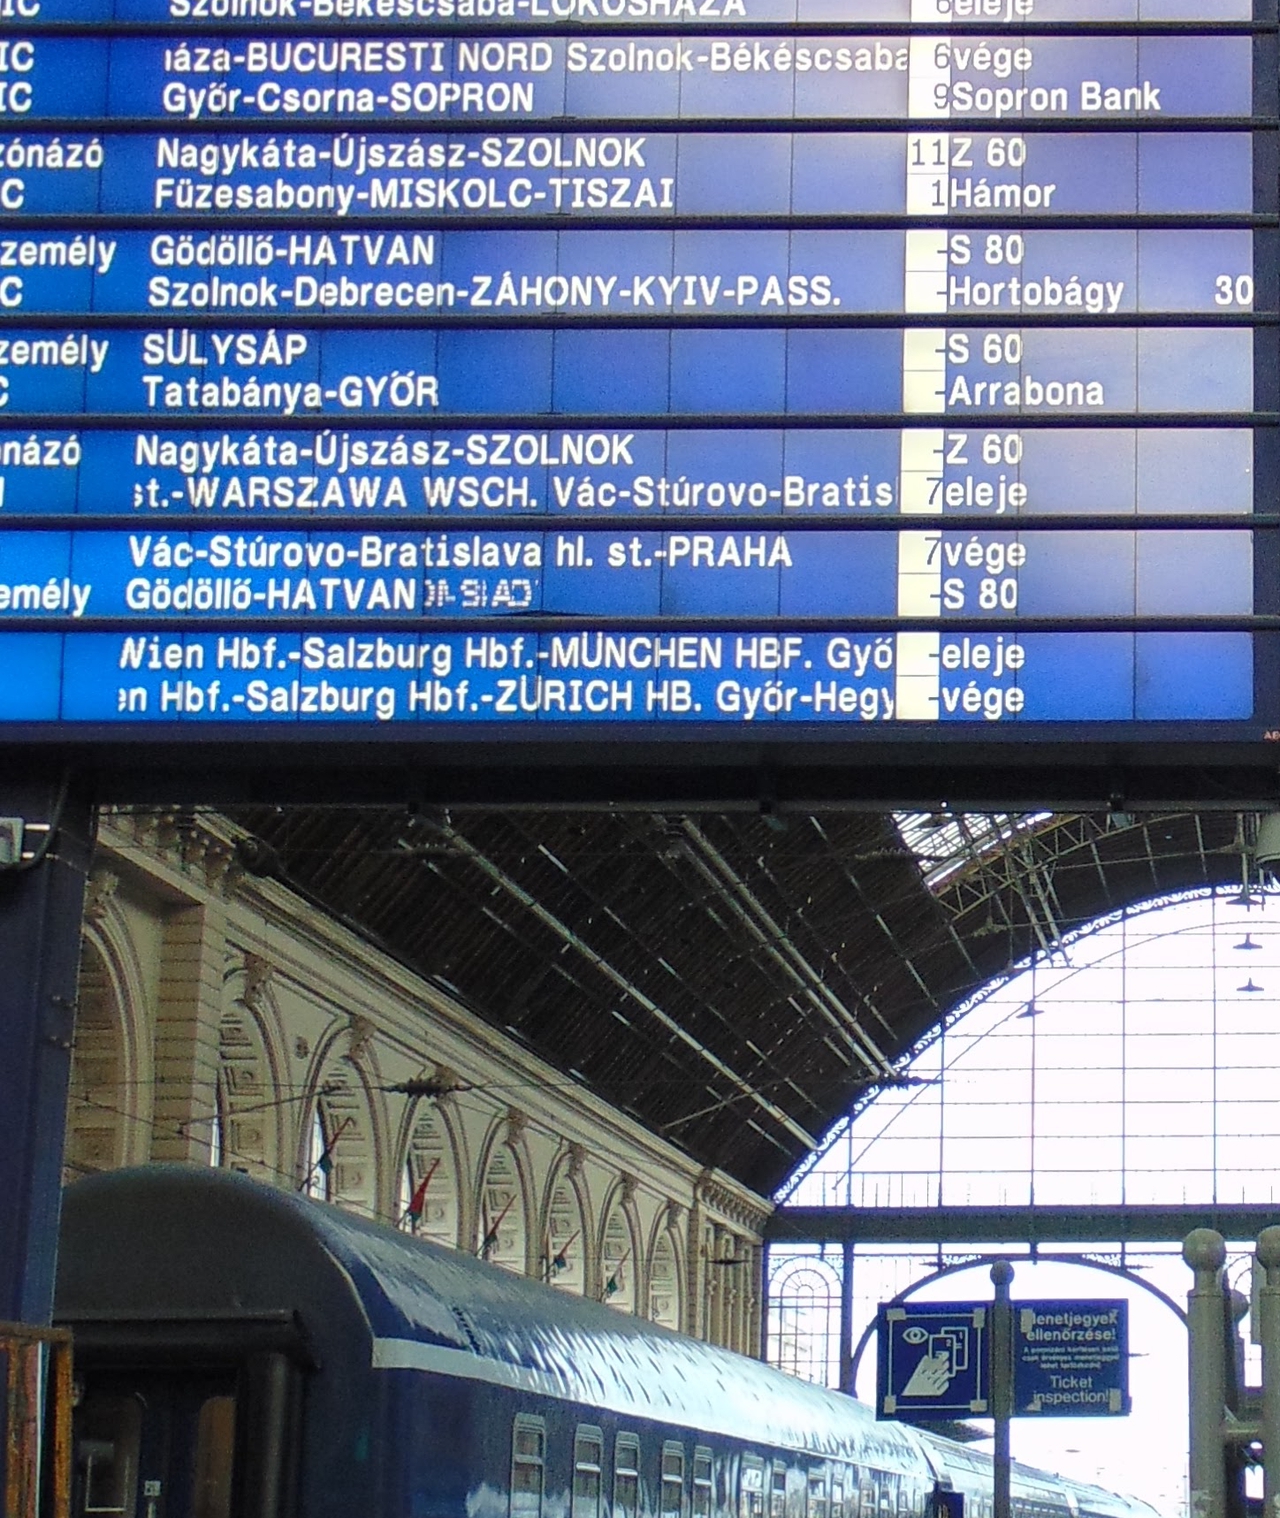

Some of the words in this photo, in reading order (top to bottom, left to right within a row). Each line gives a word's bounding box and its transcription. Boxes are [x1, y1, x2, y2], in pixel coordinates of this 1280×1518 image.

[458, 43, 552, 72] NORD
[953, 41, 1032, 78] vége
[163, 80, 533, 118] Győr-Csorna-SOPRON
[951, 80, 1068, 116] Sopron
[1081, 82, 1160, 112] Bank
[157, 134, 645, 175] Nagykáta-Újszász-SZOLNOK
[987, 139, 1026, 167] 60
[155, 178, 674, 215] Füzesabony-MISKOLC-TISZAI
[951, 178, 1056, 208] Hámor
[150, 235, 434, 265] Gödöllő-HATVAN
[985, 235, 1024, 265] 80
[149, 271, 841, 307] Szolnok-Debrecen-ZÁHONY-KYIV-PASS.
[949, 275, 1124, 313] Hortobágy
[983, 334, 1022, 364] 60
[143, 372, 438, 415] Tatabánya-GYŐR
[948, 376, 1103, 406] Arrabona
[136, 430, 634, 473] Nagykáta-Újszász-SZOLNOK
[983, 435, 1023, 464] 60
[423, 476, 538, 508] WSCH.
[946, 476, 1028, 513] eleje
[129, 535, 542, 569] Vác-Stúrovo-Bratislava
[557, 536, 593, 568] hl.
[608, 536, 793, 568] st.-PRAHA
[944, 536, 1026, 572] vége
[126, 578, 415, 611] Gödöllő-HATVAN
[979, 579, 1018, 609] 80
[218, 635, 451, 677] Hbf.-Salzburg
[466, 632, 721, 669] Hbf.-MÜNCHEN
[736, 637, 812, 669] HBF.
[942, 638, 1025, 674] eleje
[161, 679, 394, 720] Hbf.-Salzburg
[409, 676, 632, 713] Hbf.-ZÜRICH
[647, 680, 701, 712] HB.
[942, 681, 1024, 719] vége
[1027, 1327, 1116, 1341] ellenőrzése!
[1051, 1375, 1093, 1389] Ticket
